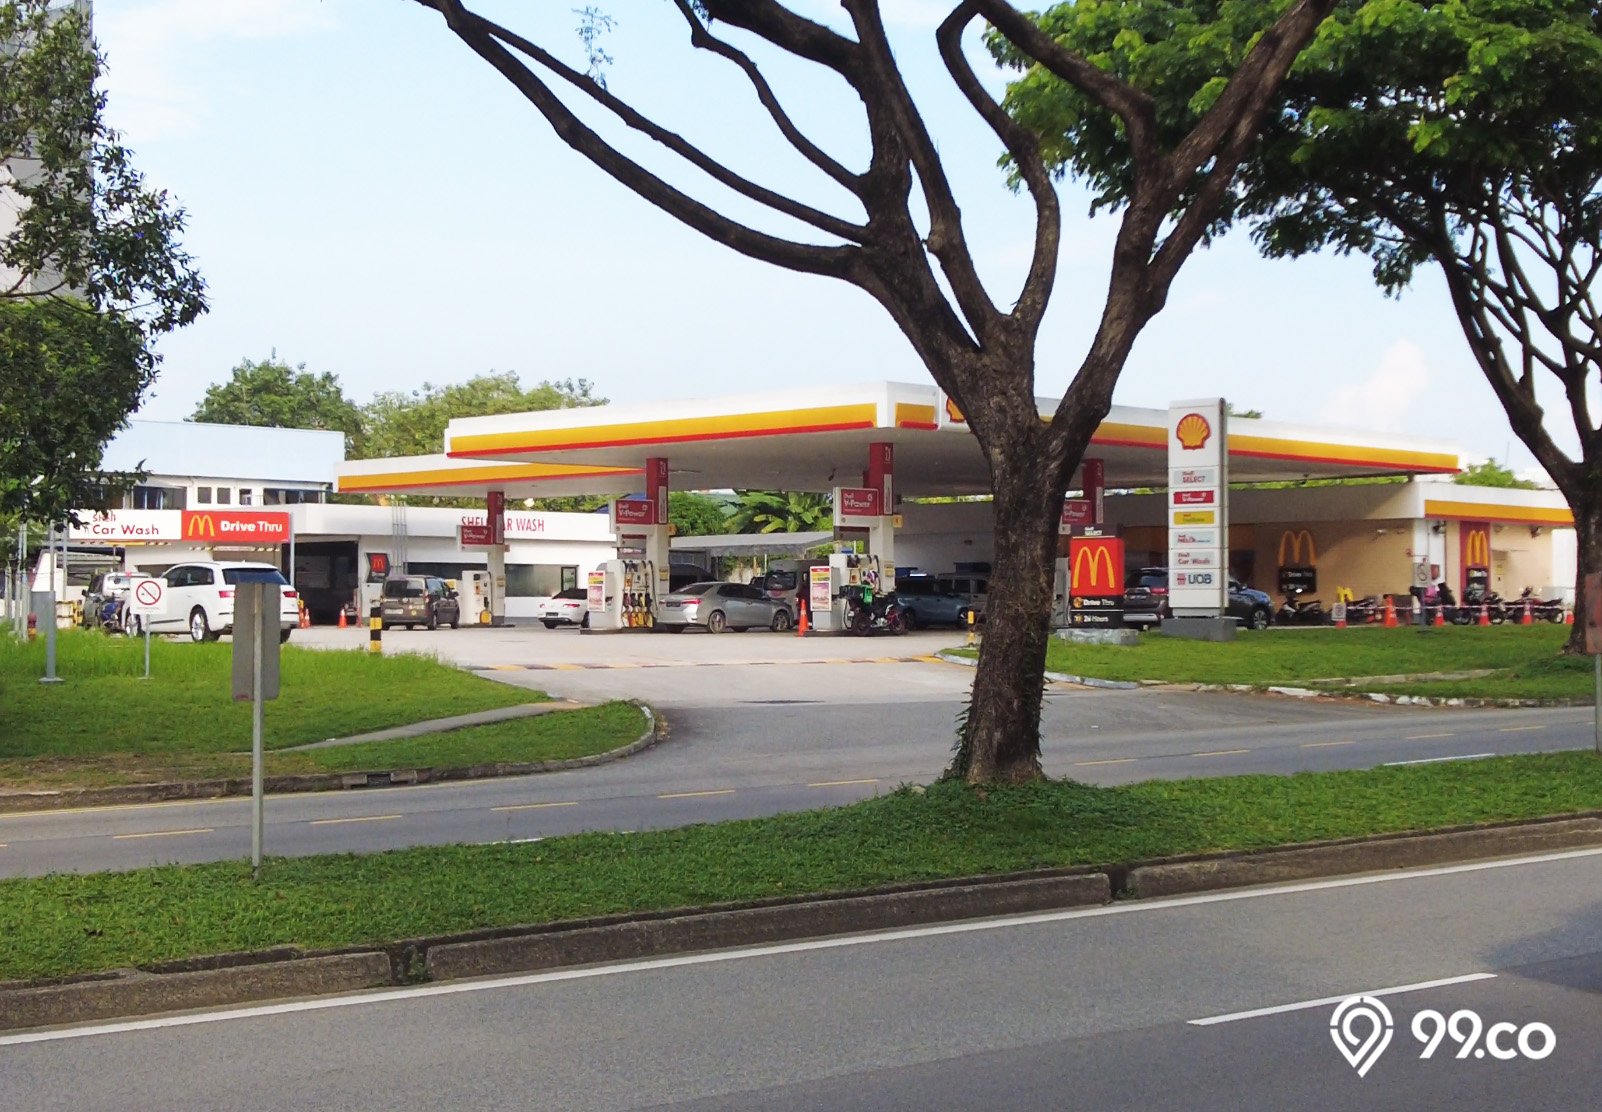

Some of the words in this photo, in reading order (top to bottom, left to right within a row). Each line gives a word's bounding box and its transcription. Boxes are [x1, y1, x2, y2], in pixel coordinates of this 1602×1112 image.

[1182, 475, 1206, 483] SELECT
[93, 524, 116, 535] Car
[121, 524, 160, 535] Wash
[220, 520, 256, 532] Drive
[257, 521, 283, 532] Thru
[516, 518, 545, 532] WASH
[1188, 573, 1213, 585] UOB
